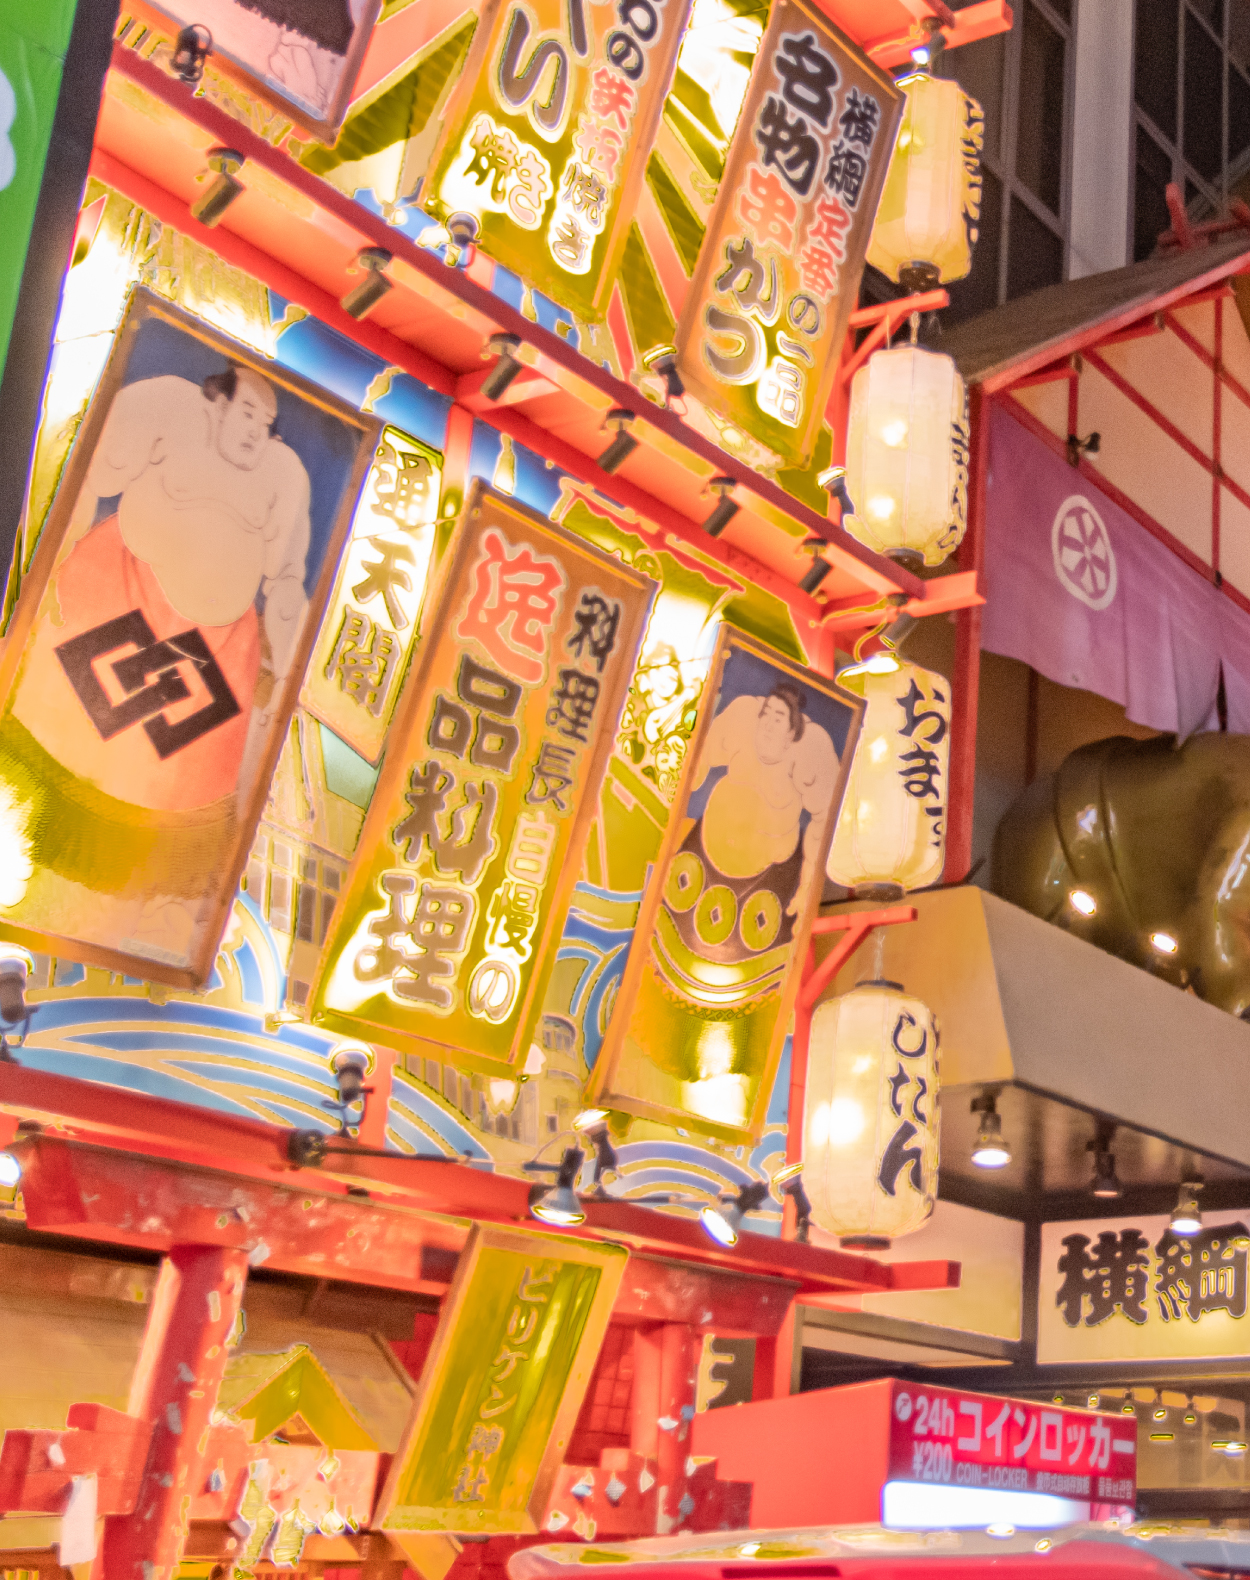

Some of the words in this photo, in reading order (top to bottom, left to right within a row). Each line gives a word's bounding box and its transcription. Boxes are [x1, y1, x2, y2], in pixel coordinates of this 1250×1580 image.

[705, 33, 838, 384] 名物串かつ
[759, 87, 878, 424] 横綱定番の一品
[324, 446, 434, 718] 通天閣
[353, 532, 563, 1006] 逸品料理
[454, 1264, 557, 1502] ビリケン神社
[1056, 1222, 1250, 1327] 横綱
[912, 1440, 951, 1480] ¥200
[914, 1396, 954, 1437] 24h
[957, 1401, 1135, 1469] コインロッカー
[956, 1464, 1028, 1489] COIN-LOCKER
